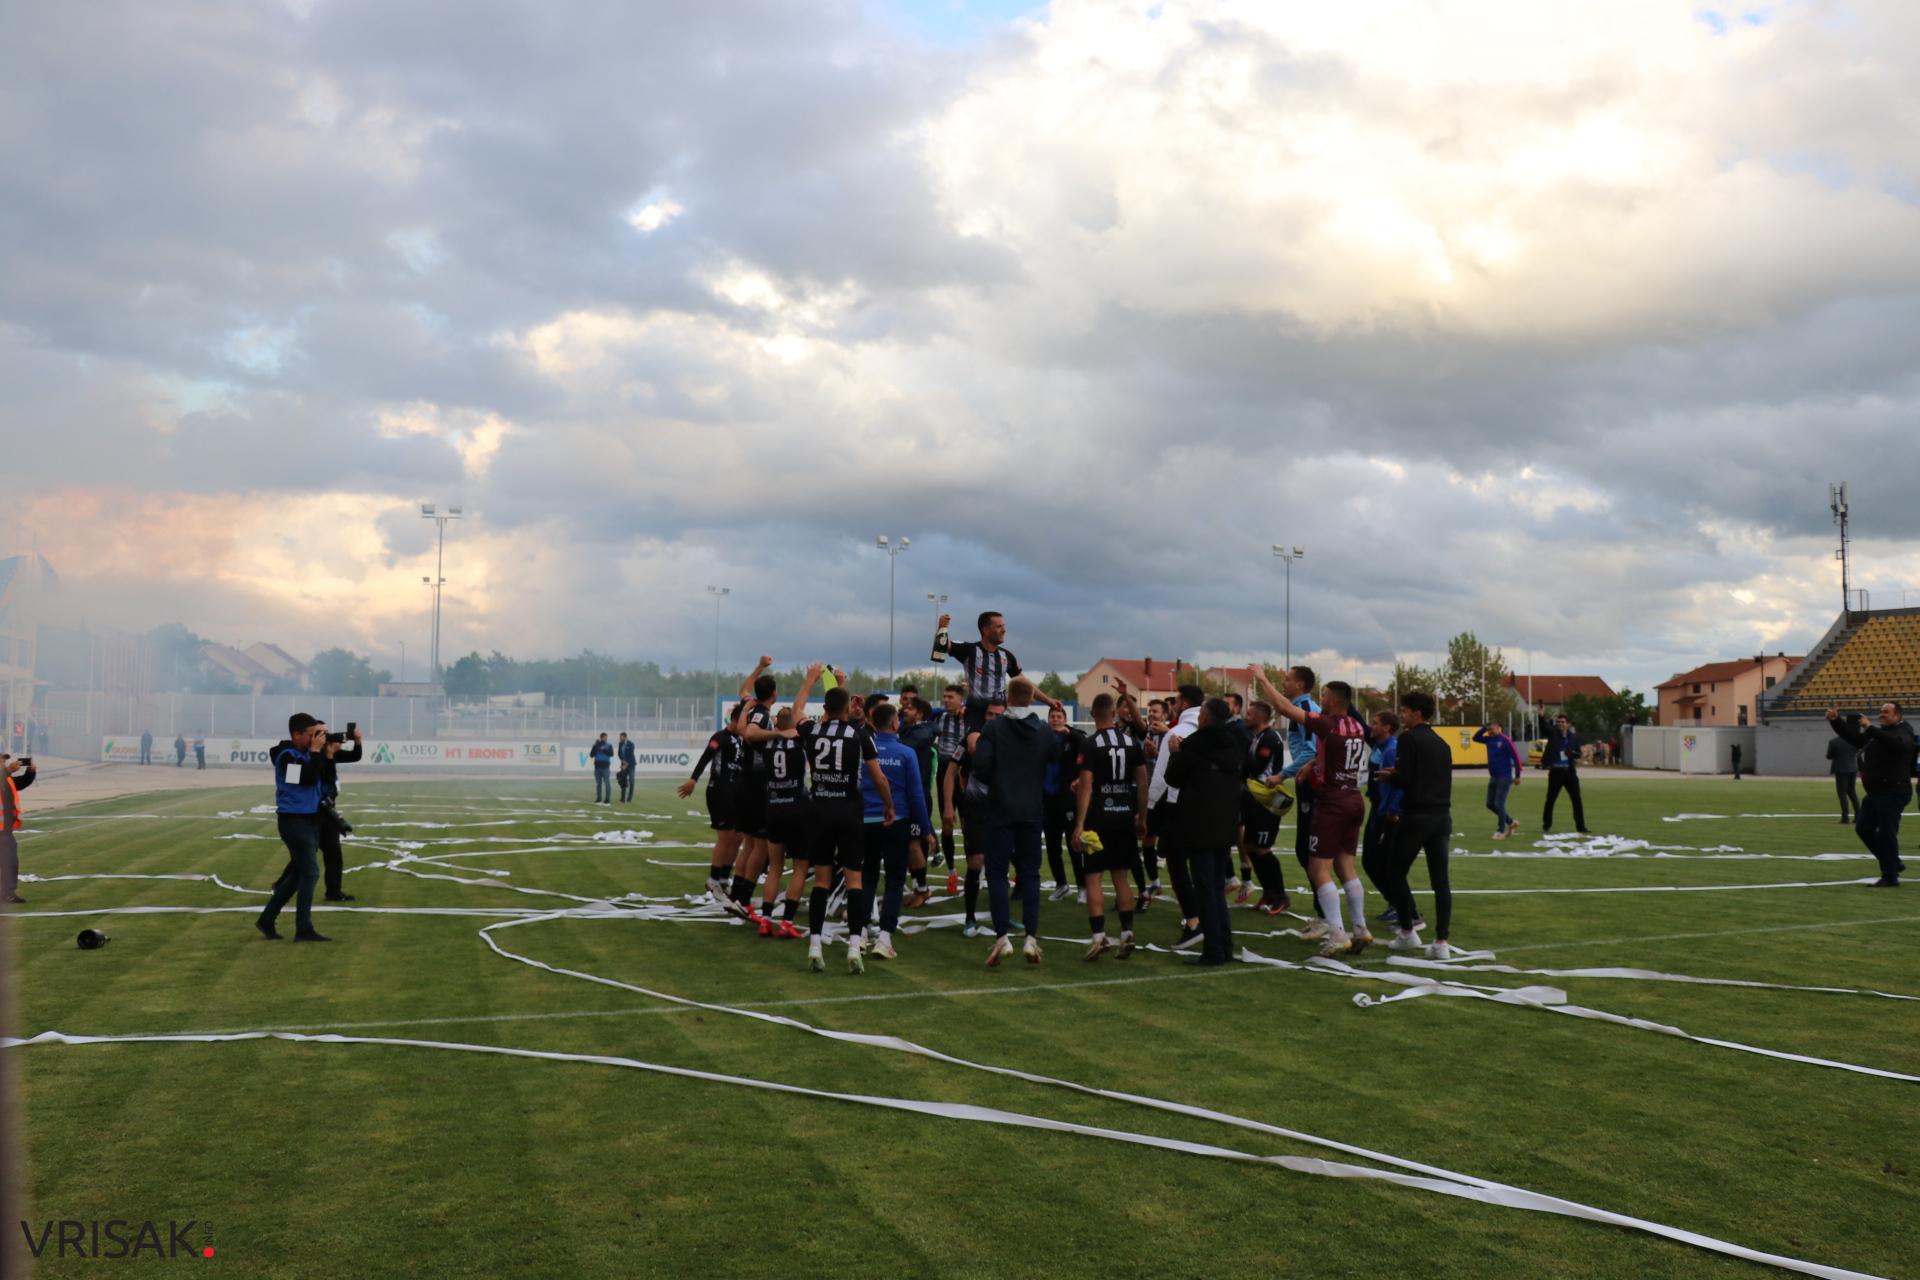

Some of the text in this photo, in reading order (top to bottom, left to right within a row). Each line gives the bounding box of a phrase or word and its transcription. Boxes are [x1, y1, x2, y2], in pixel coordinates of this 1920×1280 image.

[400, 744, 438, 756] ADEO
[639, 752, 690, 766] MIVIKO
[815, 737, 844, 770] 21
[1345, 738, 1362, 770] 12
[773, 750, 787, 778] 9
[1108, 747, 1126, 780] 11
[1257, 831, 1269, 844] 77
[1308, 836, 1319, 852] 12
